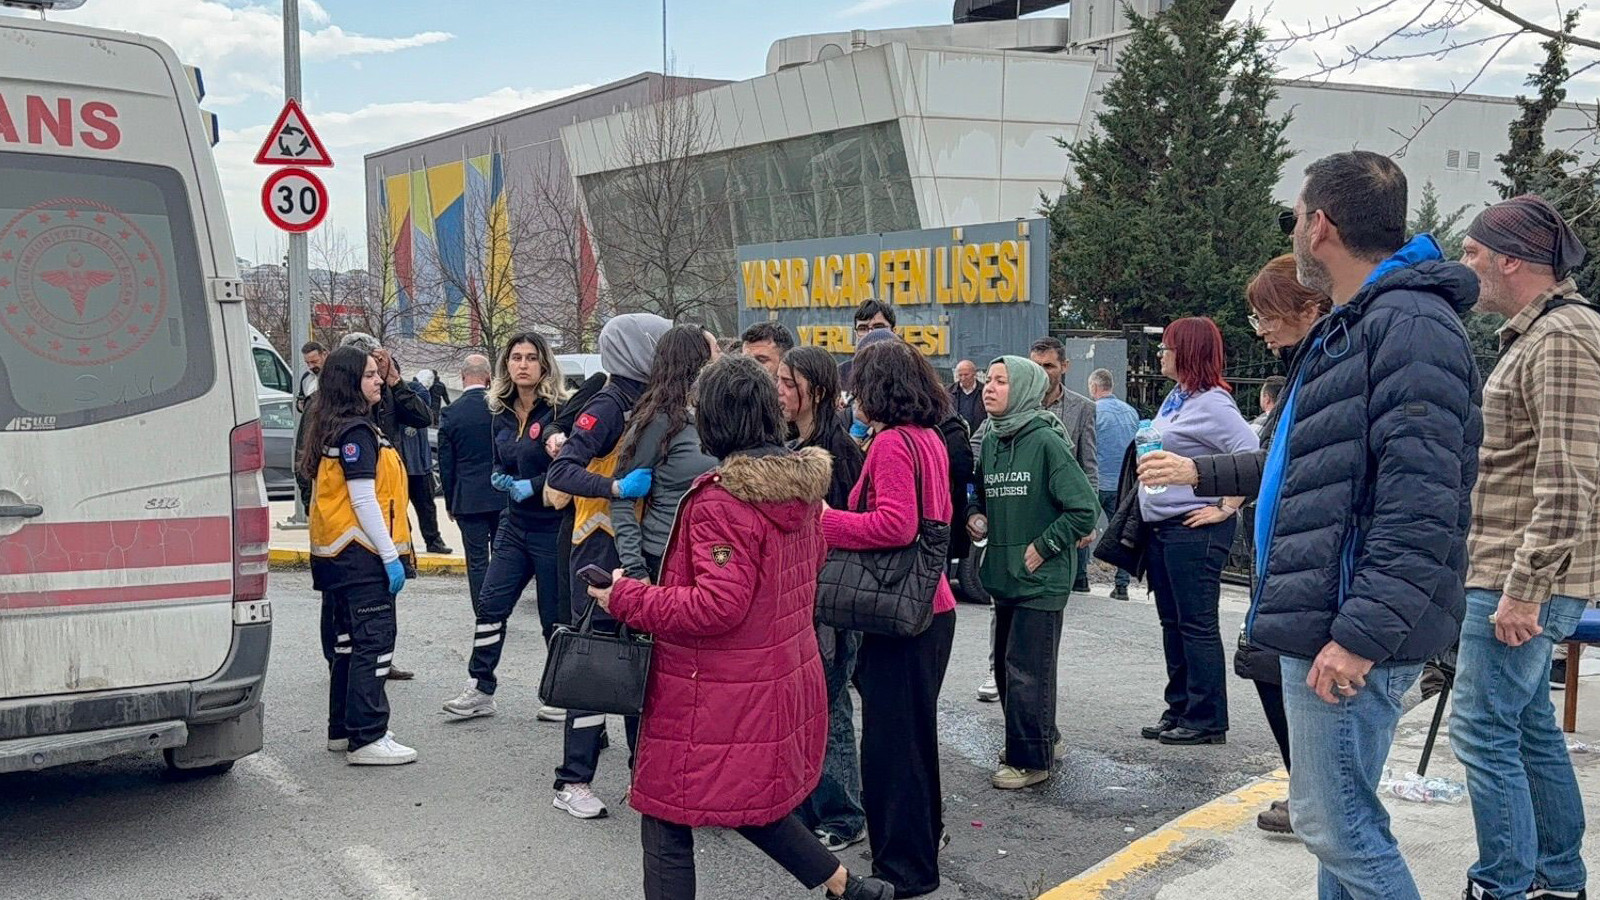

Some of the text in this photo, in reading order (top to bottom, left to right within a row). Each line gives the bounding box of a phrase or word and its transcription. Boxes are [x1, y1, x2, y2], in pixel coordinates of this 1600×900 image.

[277, 185, 317, 215] 30
[811, 253, 875, 307] ACAR
[879, 247, 931, 304] FEN
[936, 221, 1030, 304] LİSESİ
[797, 314, 950, 356] YERLESİ
